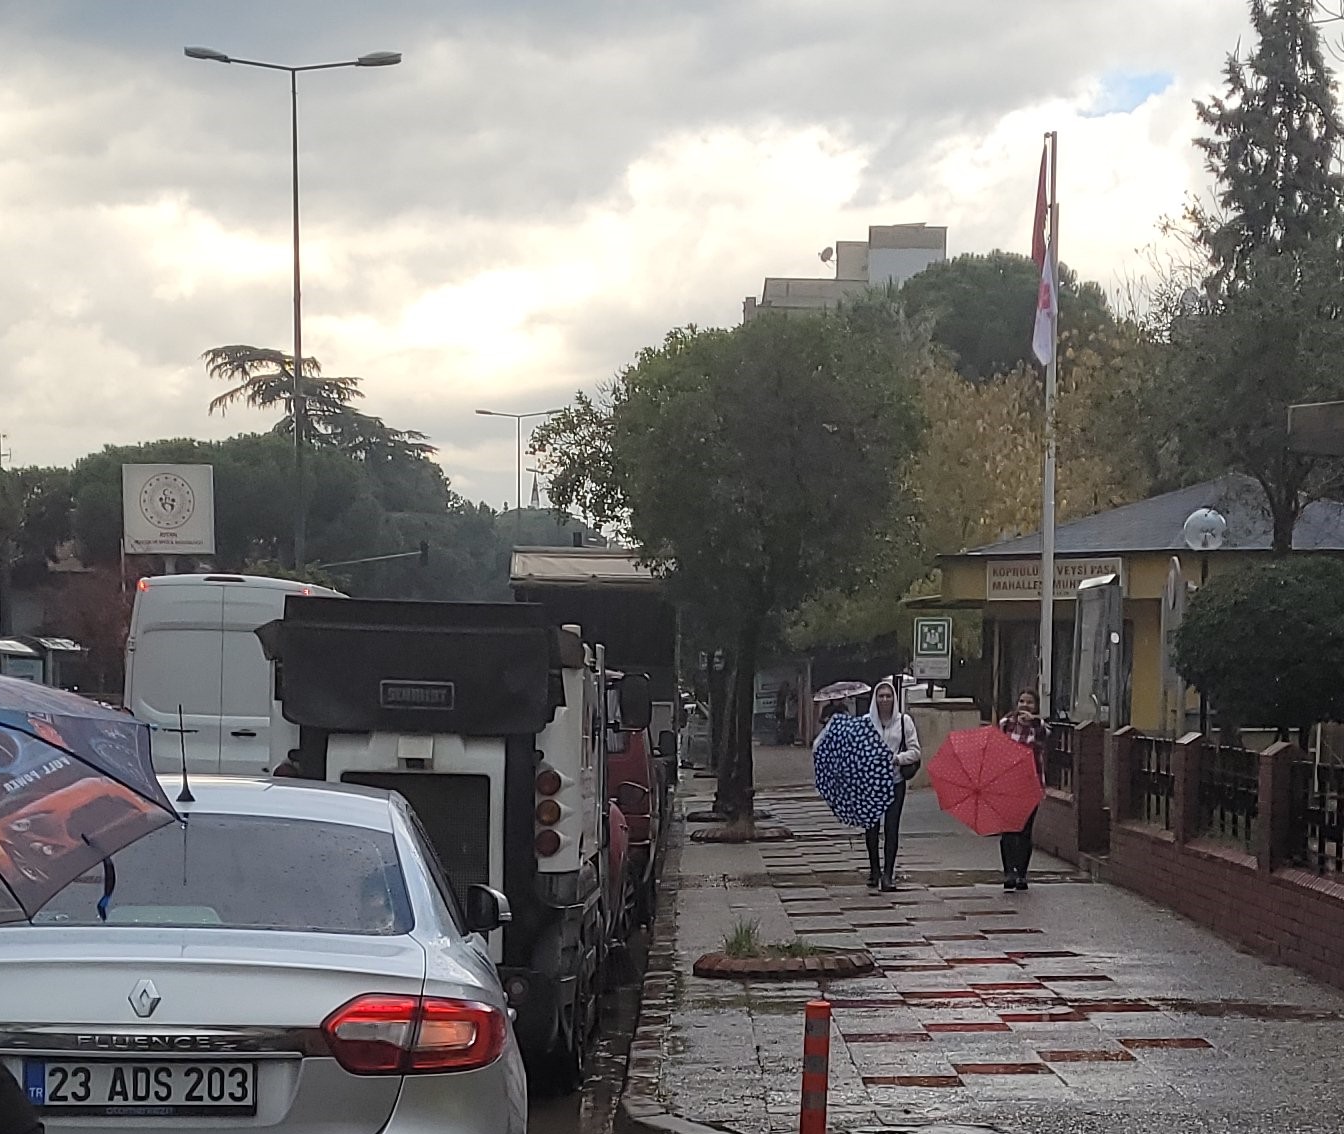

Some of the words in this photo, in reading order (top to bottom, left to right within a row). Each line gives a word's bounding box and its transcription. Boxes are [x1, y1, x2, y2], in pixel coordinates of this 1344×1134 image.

[77, 1035, 211, 1049] FLUENCE
[29, 1087, 43, 1097] TR
[48, 1066, 92, 1102] 23
[107, 1066, 173, 1102] ADS
[184, 1066, 249, 1102] 203
